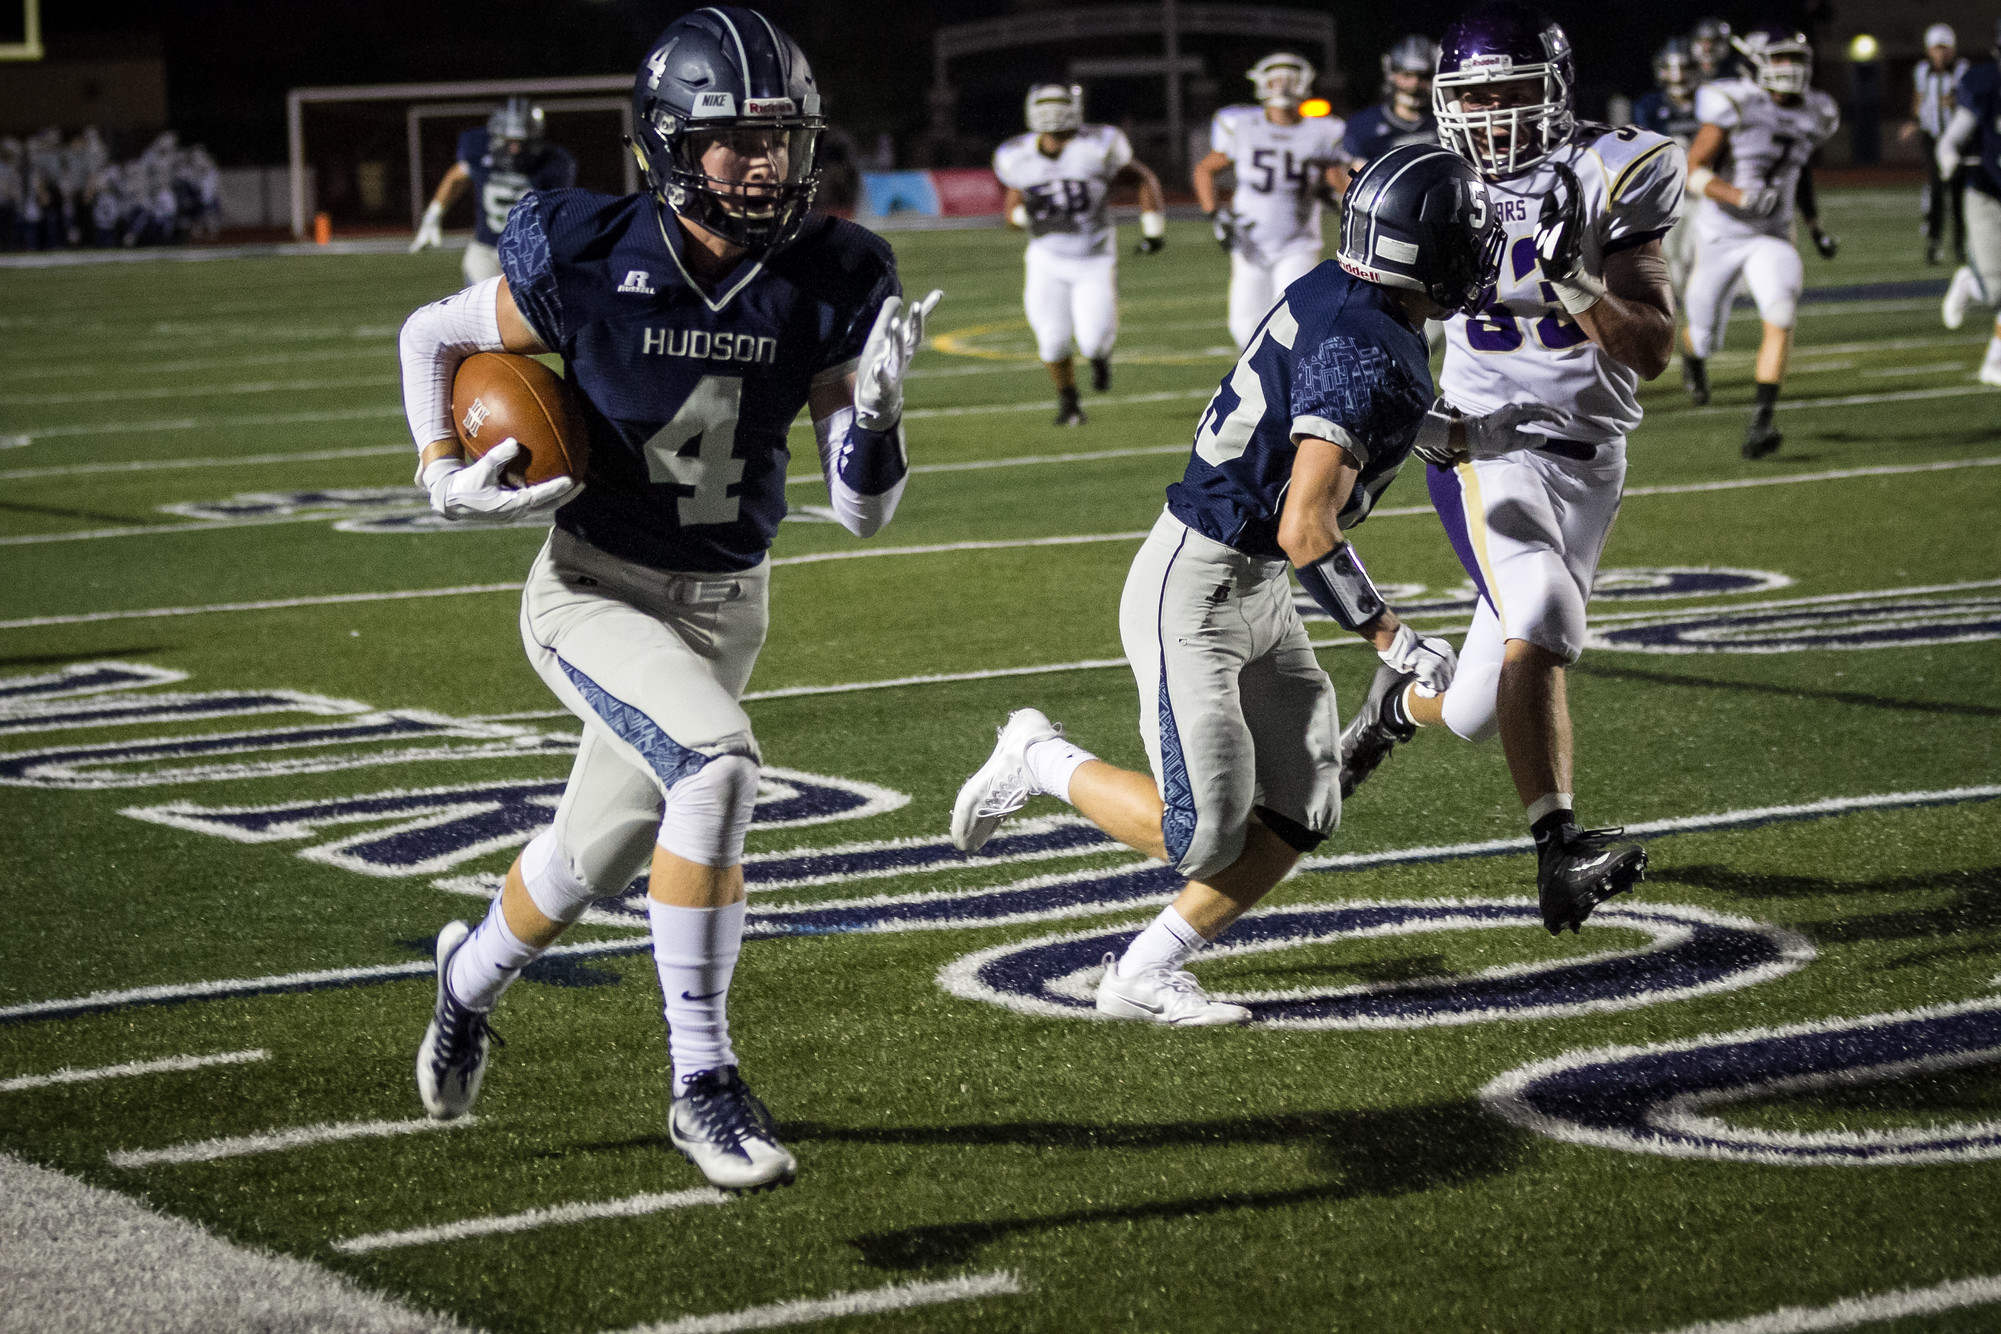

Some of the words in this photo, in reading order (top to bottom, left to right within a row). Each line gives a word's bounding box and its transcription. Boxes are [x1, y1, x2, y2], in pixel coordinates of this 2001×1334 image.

[647, 36, 679, 91] 4
[701, 94, 728, 107] NIKE
[616, 284, 656, 295] RUSSELL
[643, 327, 777, 363] HUDSON
[643, 375, 746, 527] 4
